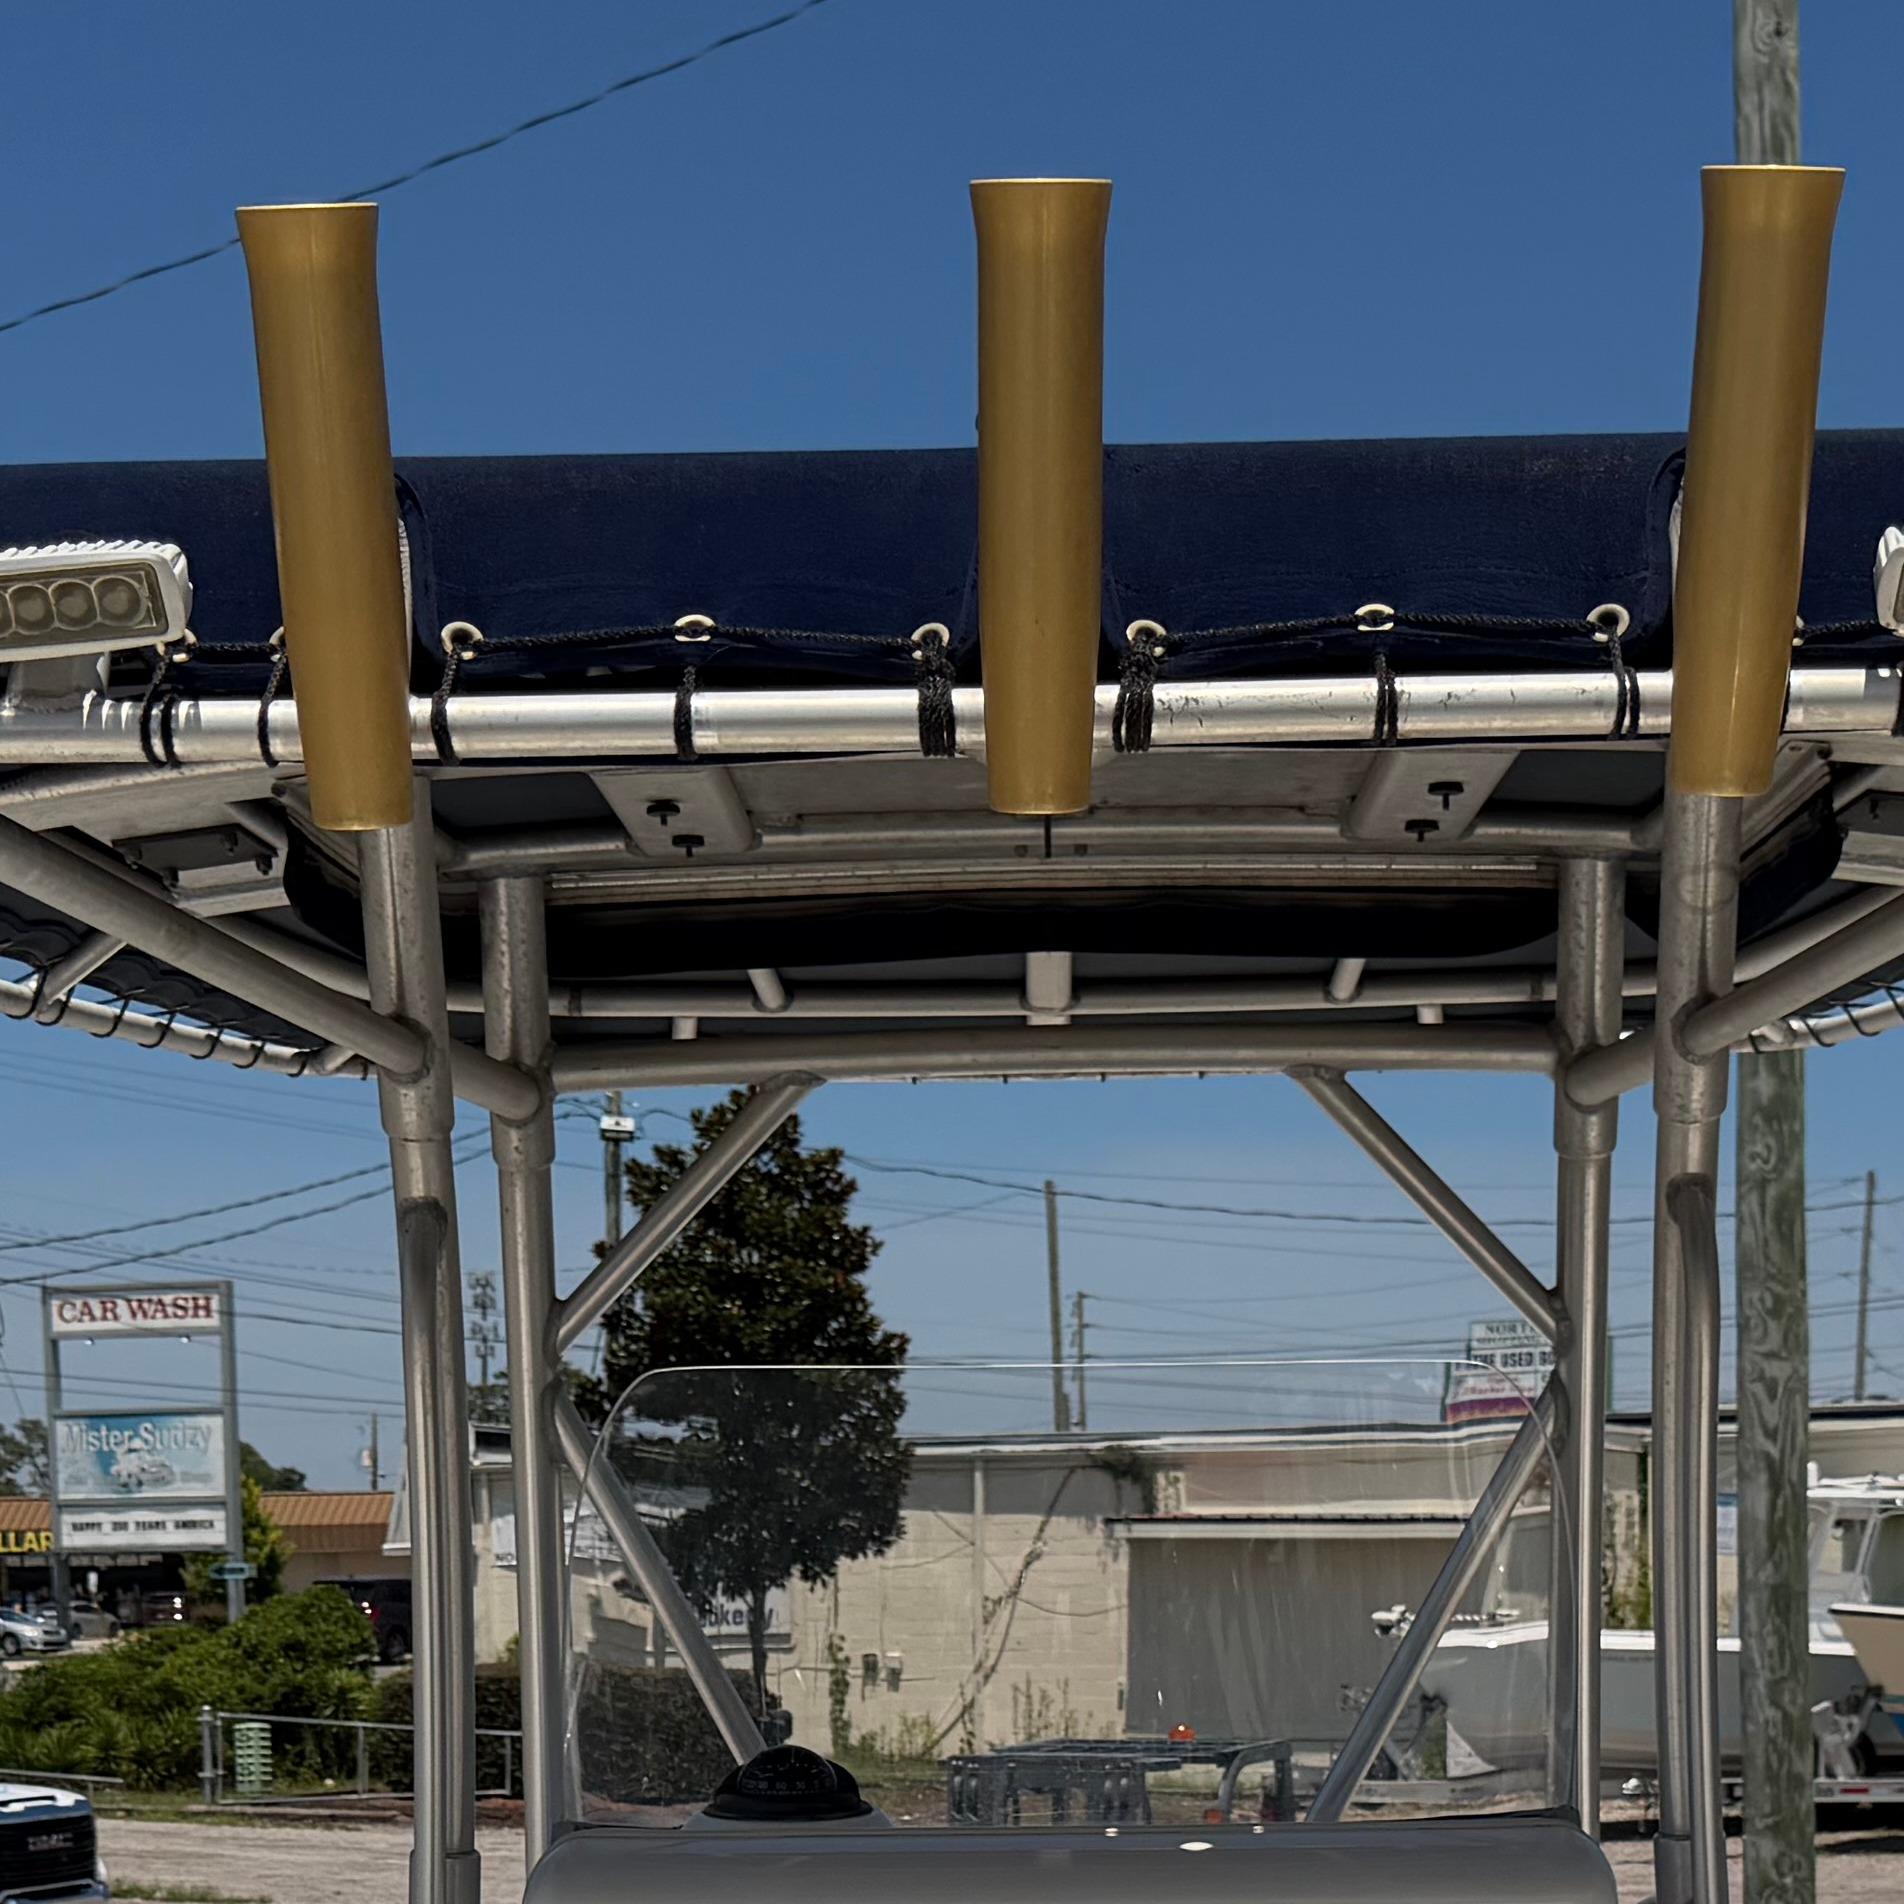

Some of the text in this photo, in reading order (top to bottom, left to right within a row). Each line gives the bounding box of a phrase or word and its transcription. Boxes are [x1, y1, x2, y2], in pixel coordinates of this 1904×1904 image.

[57, 1295, 214, 1324] CAR WASH
[1500, 1352, 1534, 1367] USED
[62, 1422, 133, 1452] Mister
